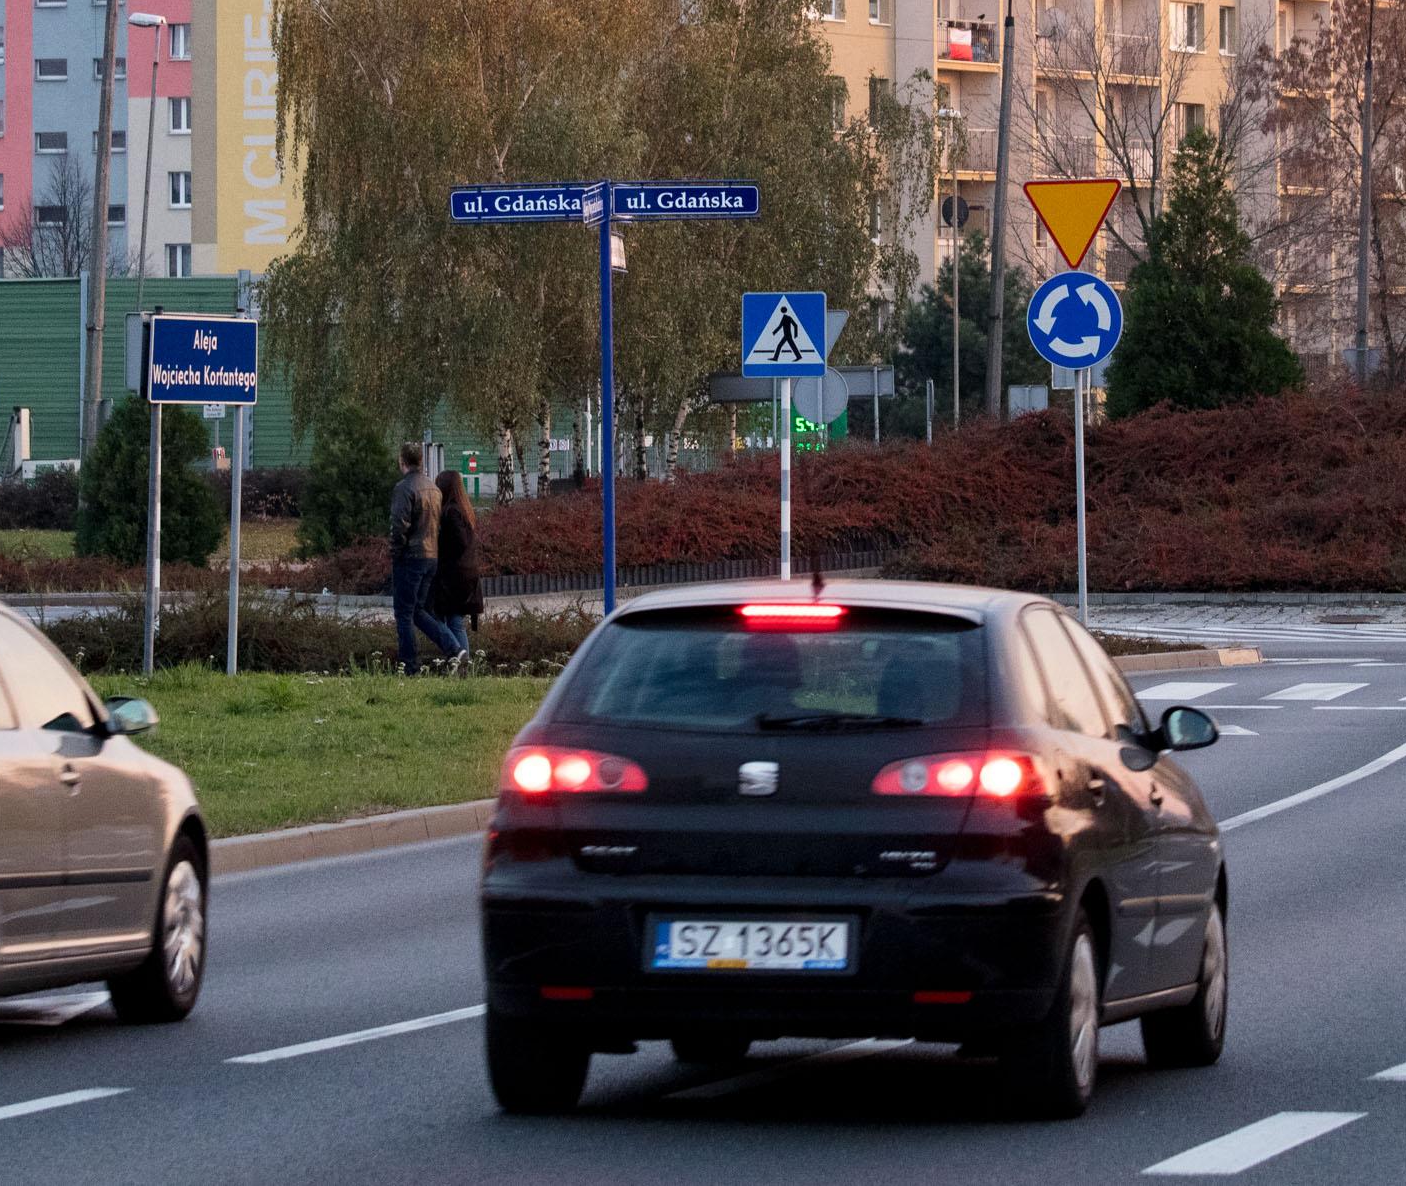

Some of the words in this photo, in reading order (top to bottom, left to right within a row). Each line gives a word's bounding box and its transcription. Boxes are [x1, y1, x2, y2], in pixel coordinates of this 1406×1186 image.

[464, 197, 489, 214] ul.
[494, 193, 583, 212] Gdańska
[626, 193, 651, 210] ul.
[656, 190, 745, 210] Gdańska
[193, 329, 218, 355] Aleja
[153, 364, 201, 390] Wojciecha
[204, 365, 257, 392] Korfantego
[677, 924, 721, 958] SZ
[735, 924, 838, 958] 1365K
